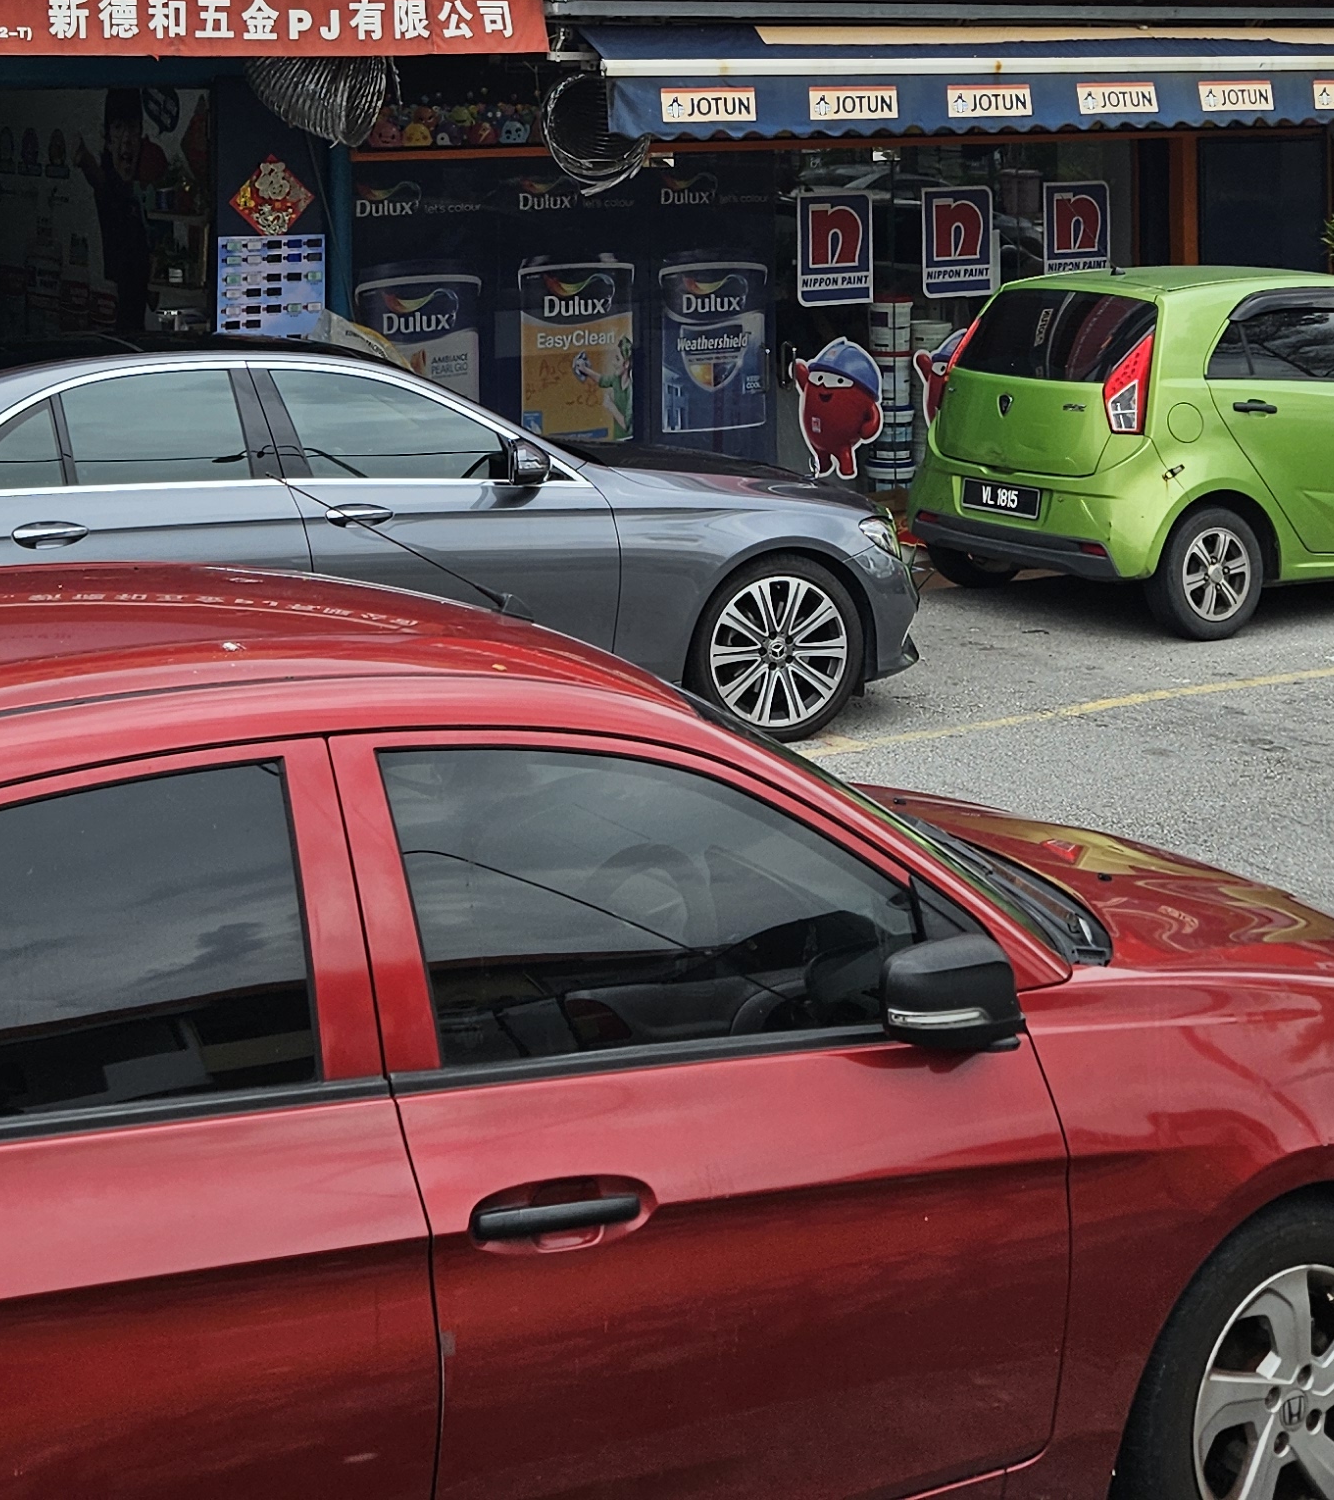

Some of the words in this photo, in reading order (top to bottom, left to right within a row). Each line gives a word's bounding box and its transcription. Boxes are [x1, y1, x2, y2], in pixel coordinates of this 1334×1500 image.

[688, 96, 751, 117] JOTUN
[1100, 91, 1153, 108] JOTUN
[802, 275, 839, 288] NIPPON
[840, 275, 869, 286] PAINT
[926, 268, 962, 280] NIPPON
[963, 267, 989, 278] PAINT
[543, 295, 605, 317] Dulux
[682, 294, 740, 314] Dulux
[383, 312, 450, 334] Dulux
[537, 330, 615, 350] EasyClean
[677, 333, 748, 351] Weathershield
[982, 485, 995, 505] VL
[997, 487, 1018, 509] 1815
